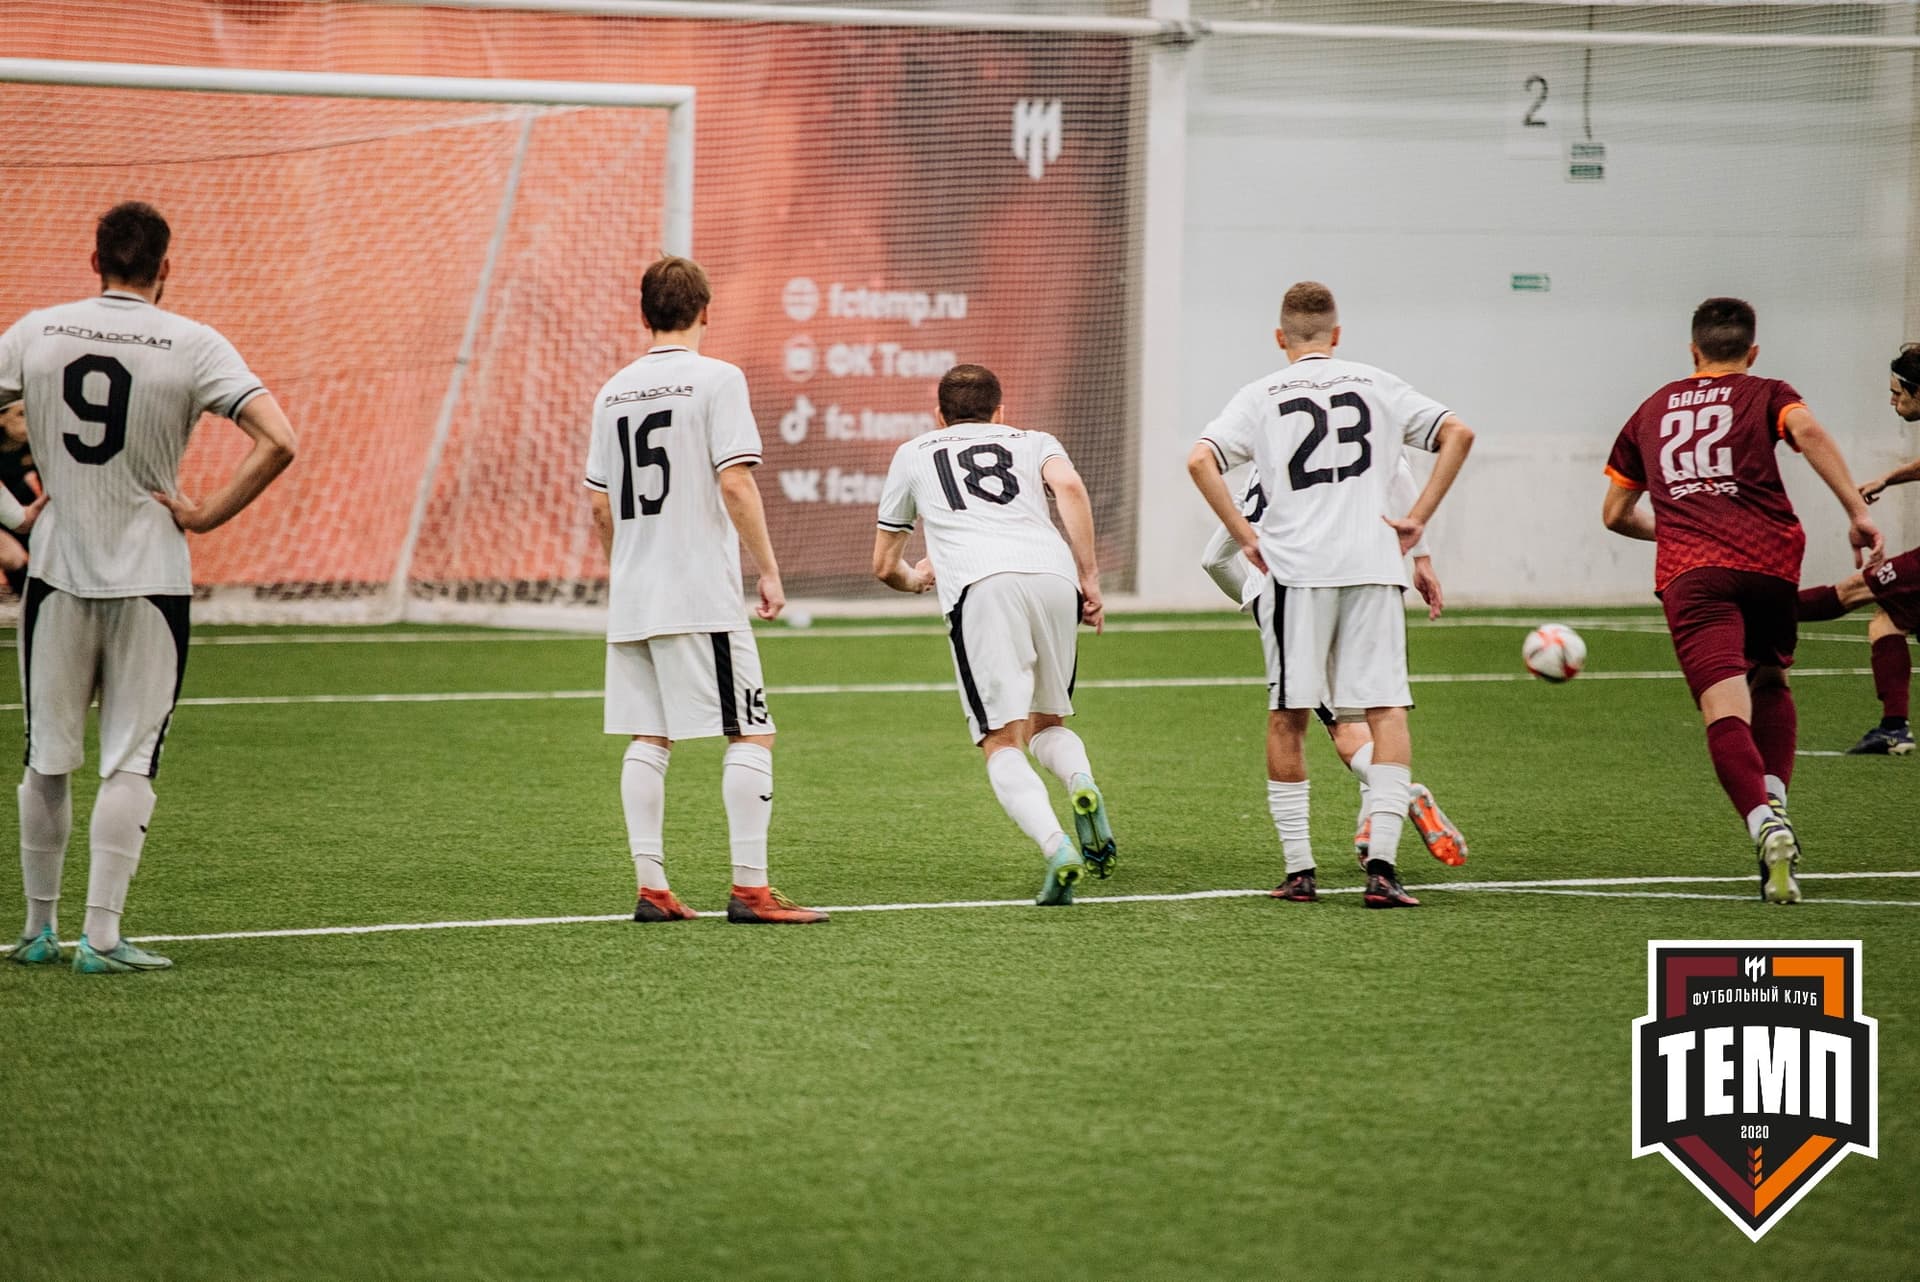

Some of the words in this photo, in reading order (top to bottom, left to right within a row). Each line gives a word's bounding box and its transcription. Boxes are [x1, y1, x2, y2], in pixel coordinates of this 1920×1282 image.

[1523, 75, 1549, 128] 2
[828, 283, 967, 326] fctemp.ru
[62, 353, 132, 465] 9
[1667, 386, 1733, 410] БАБИЧ
[617, 409, 672, 521] 15
[1278, 391, 1372, 491] 23
[1660, 404, 1734, 484] 22
[933, 442, 1021, 513] 18
[1876, 561, 1897, 585] 23
[745, 687, 768, 725] 15
